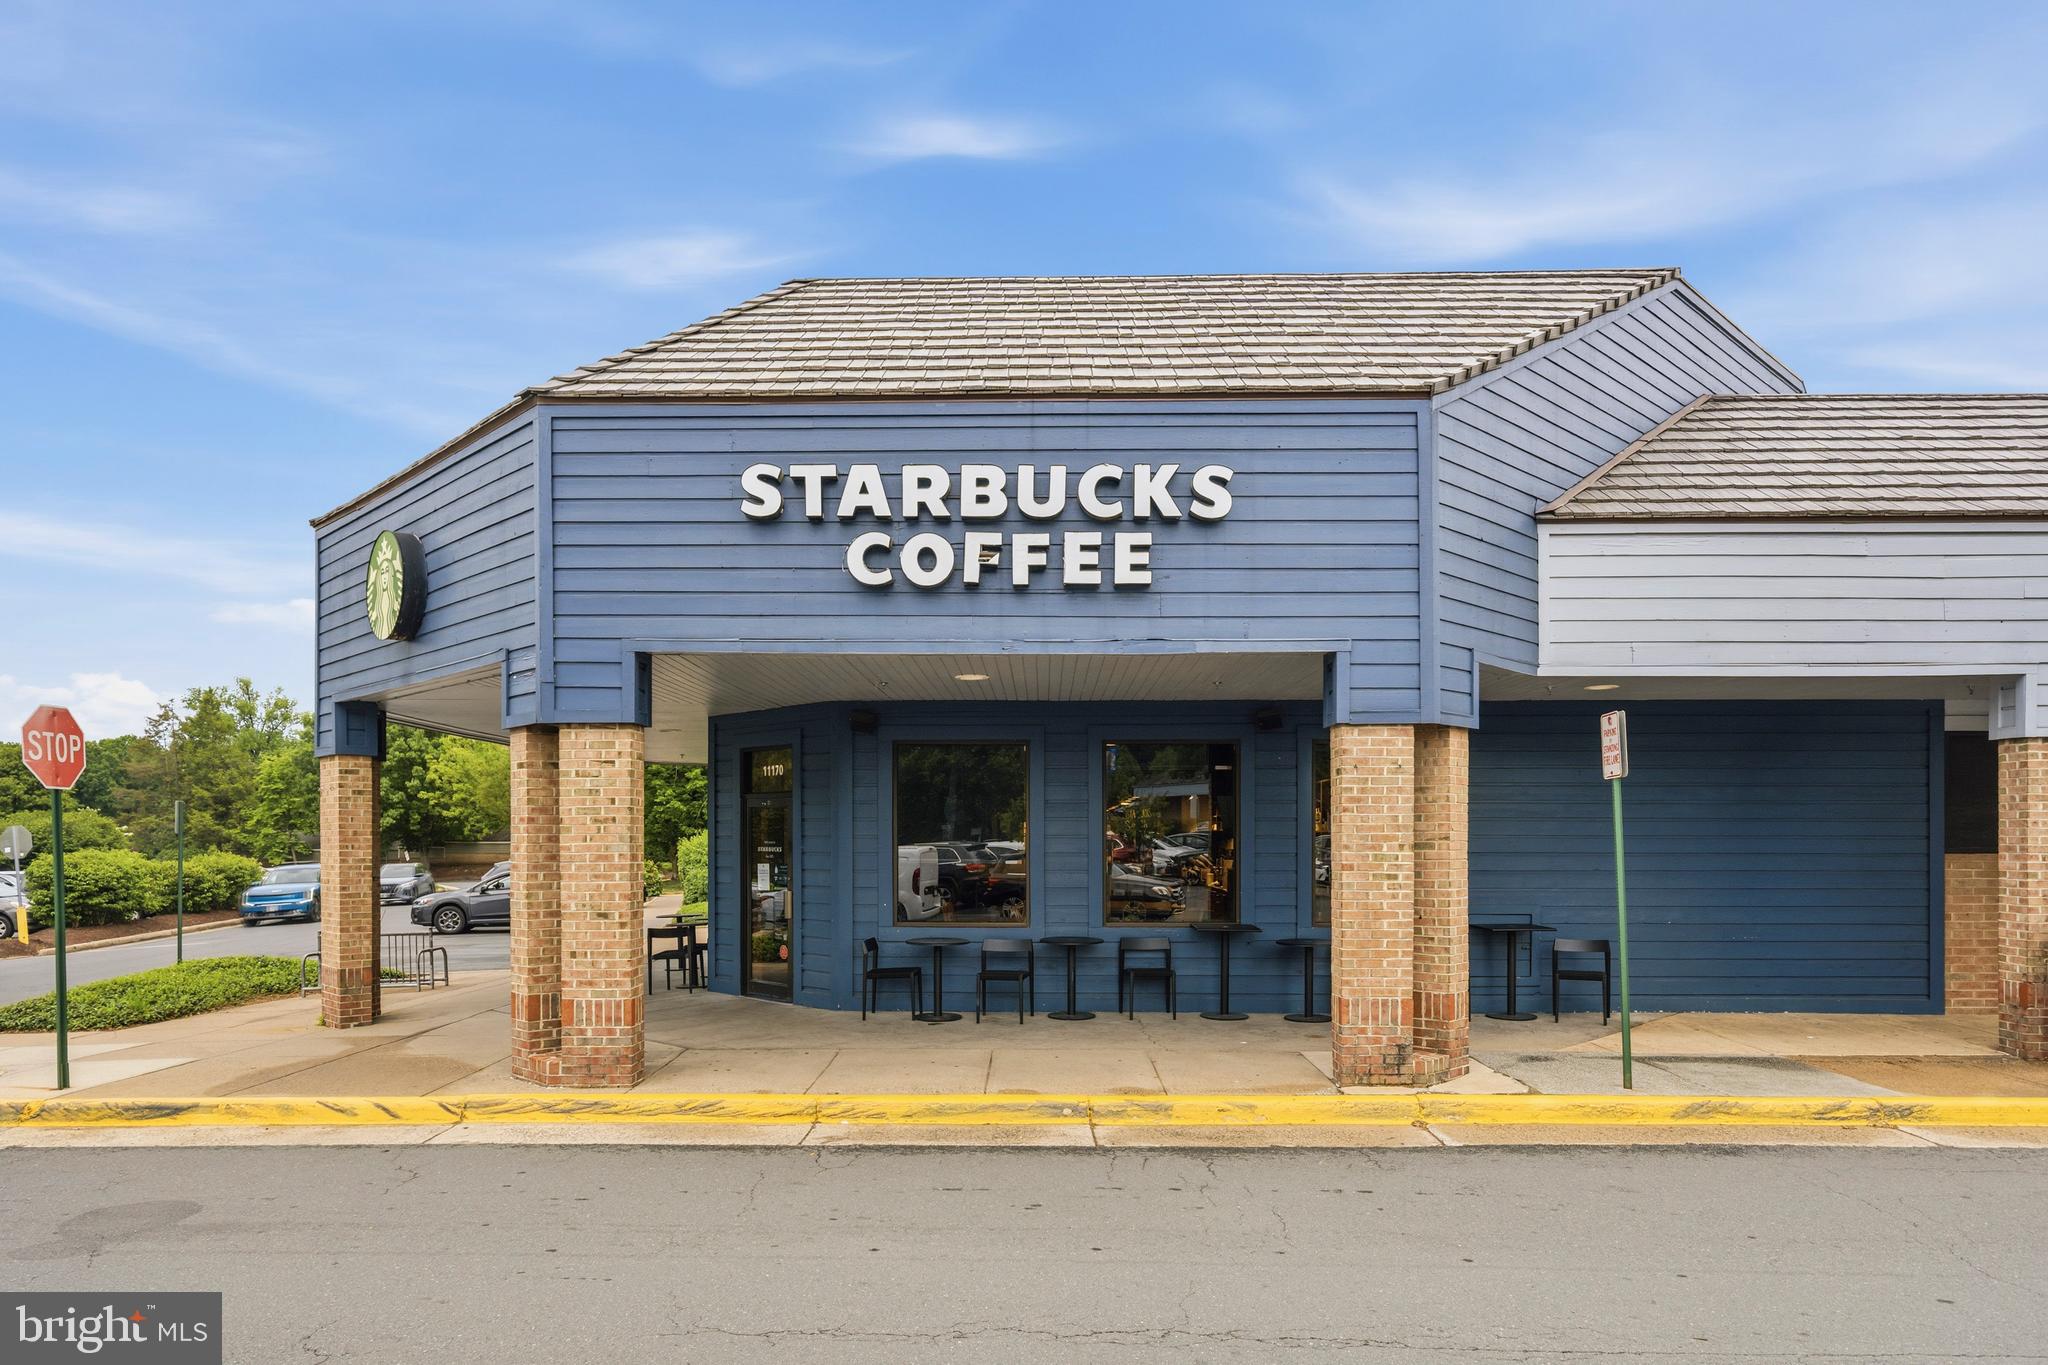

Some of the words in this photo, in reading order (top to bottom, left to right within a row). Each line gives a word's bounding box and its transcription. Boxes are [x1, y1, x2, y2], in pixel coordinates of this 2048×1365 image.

[740, 463, 1235, 521] STARBUCKS
[845, 531, 1154, 588] COFFEE
[28, 730, 81, 764] STOP
[763, 765, 784, 777] 11170
